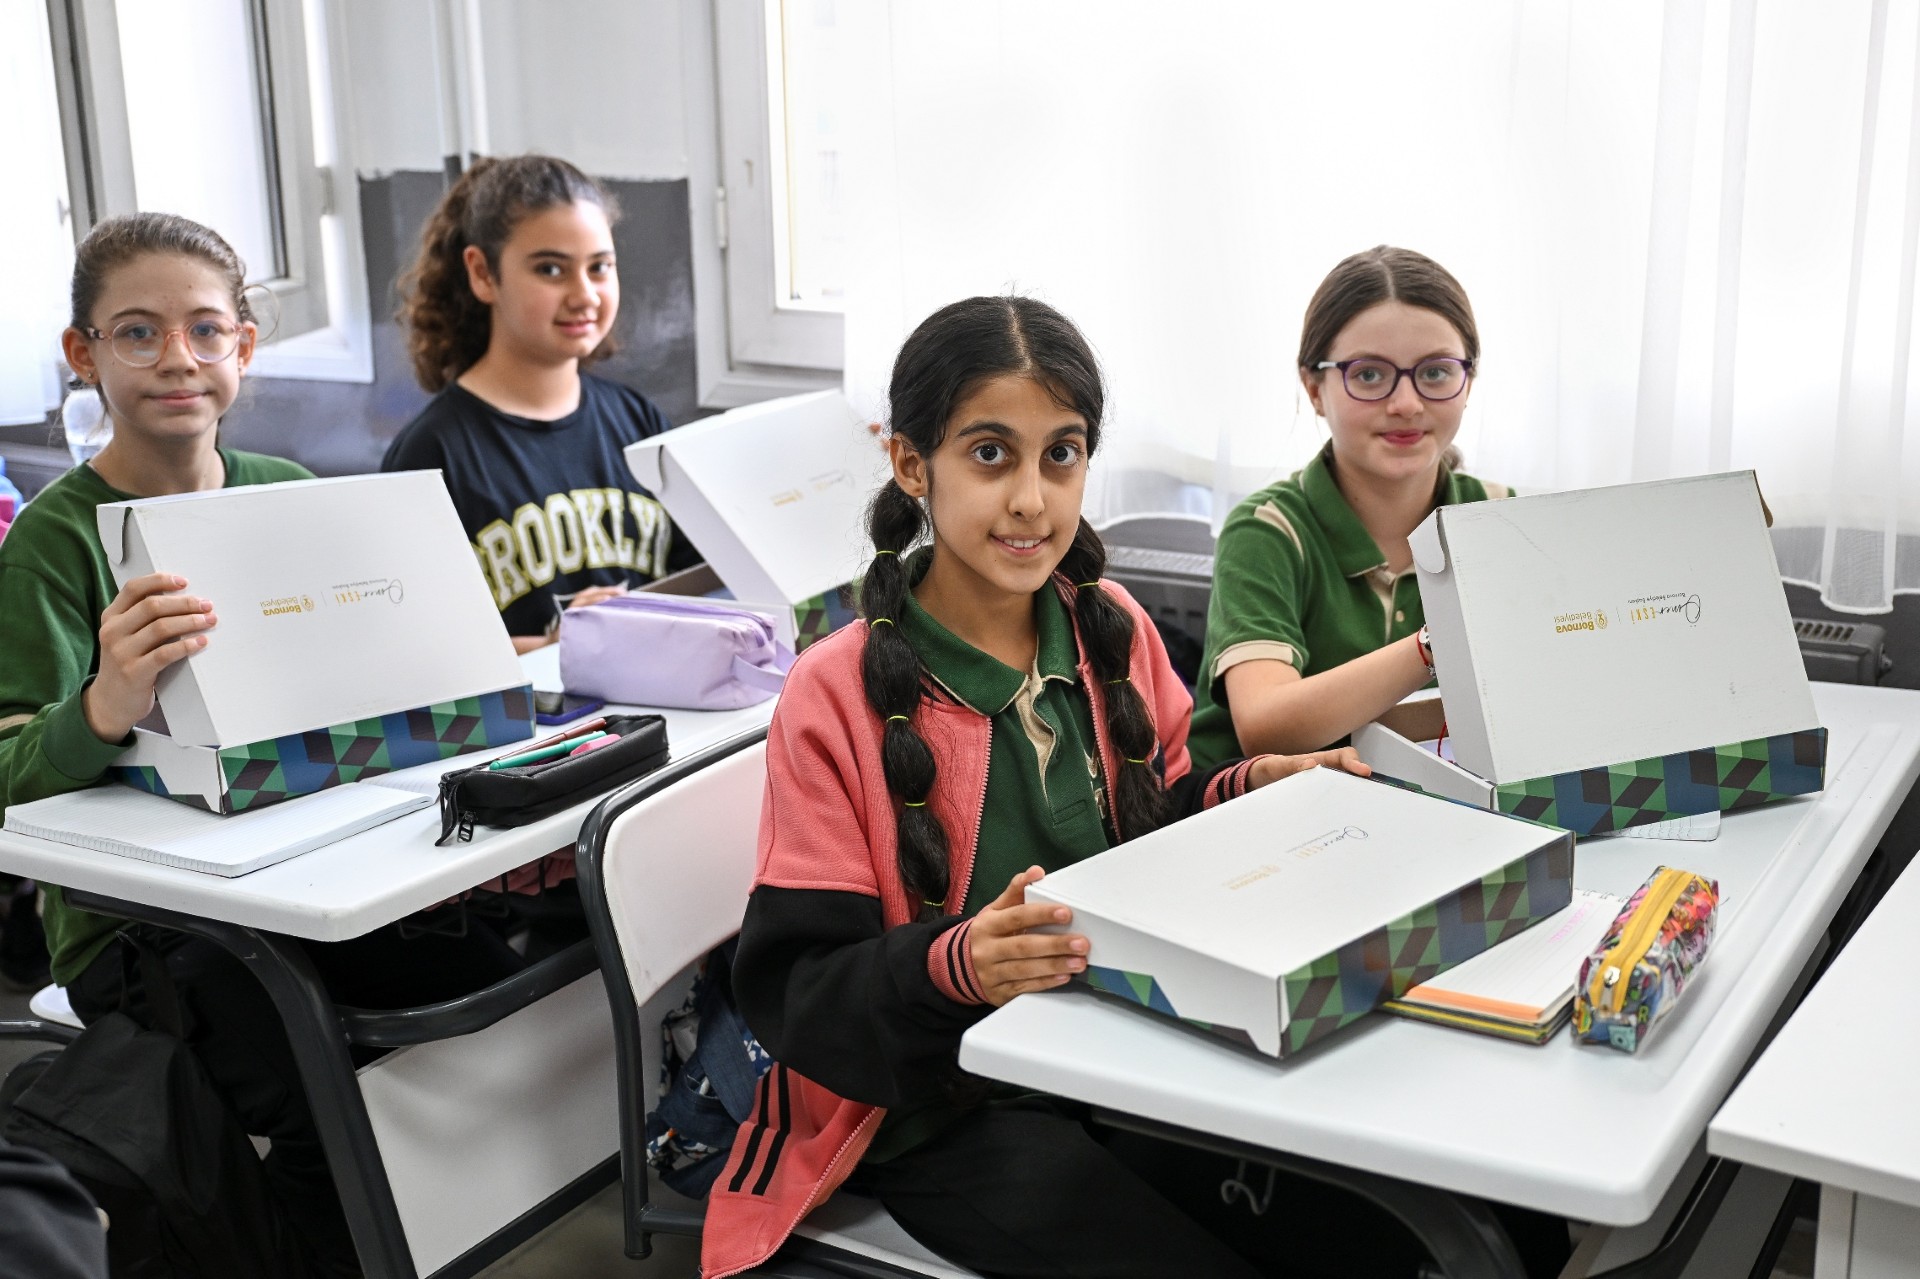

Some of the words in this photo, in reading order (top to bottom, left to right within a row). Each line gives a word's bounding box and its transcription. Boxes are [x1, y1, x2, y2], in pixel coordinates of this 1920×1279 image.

[470, 487, 673, 612] ROOKLY
[259, 596, 299, 608] Belediyesi
[263, 604, 302, 617] Bornova
[1553, 611, 1593, 624] Belediyesi
[1555, 620, 1595, 634] Bornova
